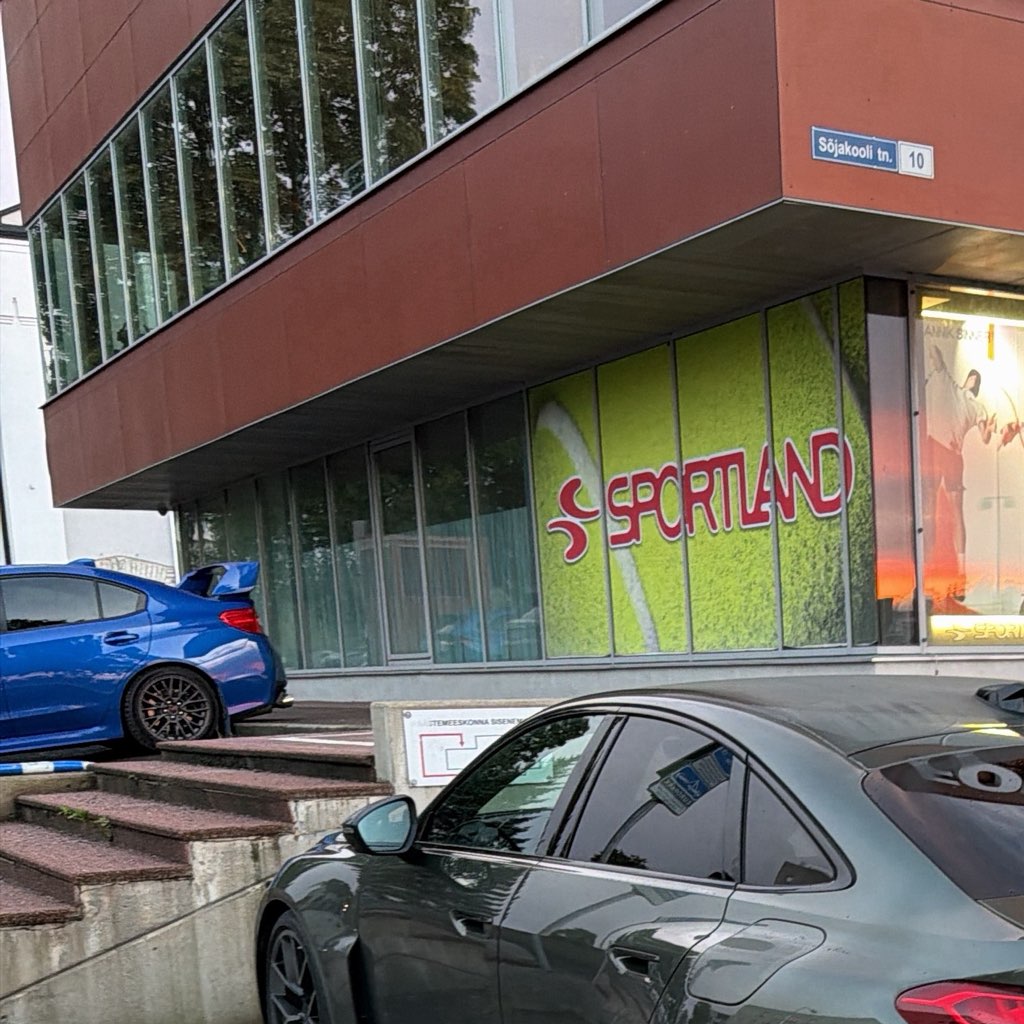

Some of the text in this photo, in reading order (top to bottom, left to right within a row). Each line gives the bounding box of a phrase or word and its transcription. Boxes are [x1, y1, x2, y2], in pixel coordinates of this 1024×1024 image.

[818, 136, 924, 169] Sõjakooli tn. 10
[607, 428, 854, 547] SPORTLAND
